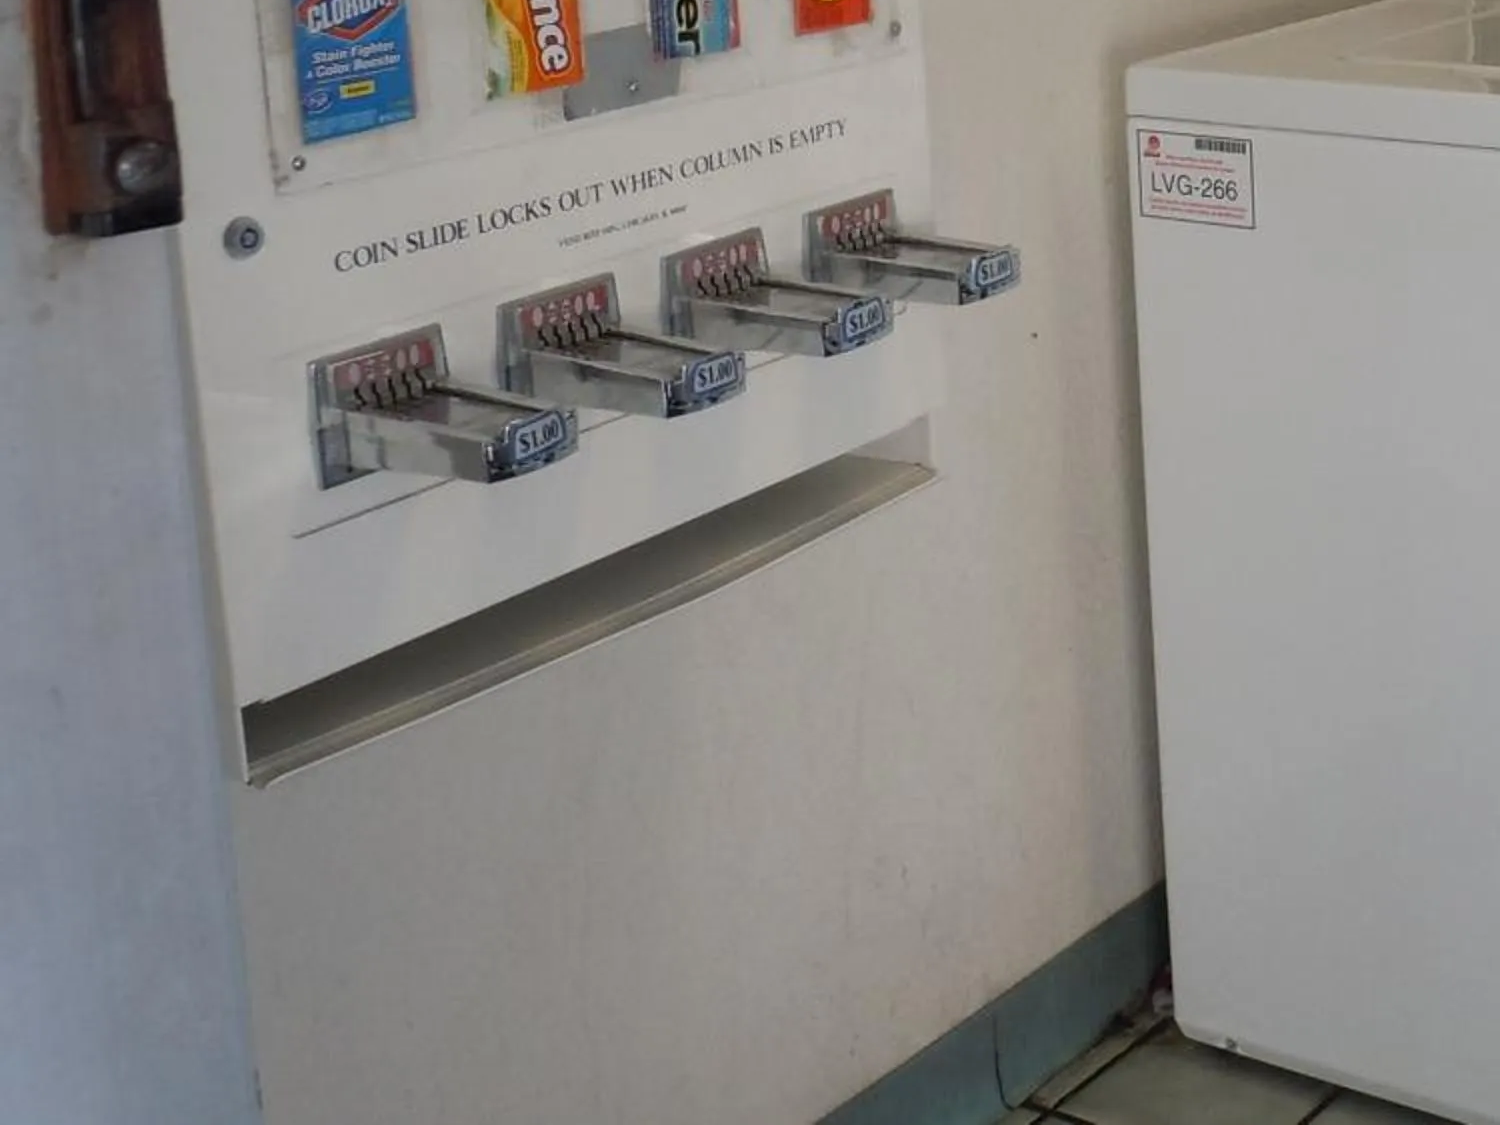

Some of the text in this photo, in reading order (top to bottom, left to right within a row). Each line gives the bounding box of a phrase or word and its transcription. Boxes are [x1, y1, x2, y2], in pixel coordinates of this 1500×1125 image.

[311, 48, 347, 65] Stain
[314, 61, 352, 78] Color
[333, 236, 399, 273] COIN
[404, 217, 471, 254] SLIDE
[476, 195, 552, 235] LOCKS
[558, 182, 605, 213] OUT
[610, 163, 674, 198] WHEN
[678, 140, 764, 180] COLUMN
[768, 134, 784, 156] IS
[789, 118, 848, 150] EMPTY
[1150, 170, 1239, 202] LVG-266
[848, 306, 882, 333] $1.00
[697, 360, 734, 388] $1.00
[518, 419, 560, 454] $1.00
